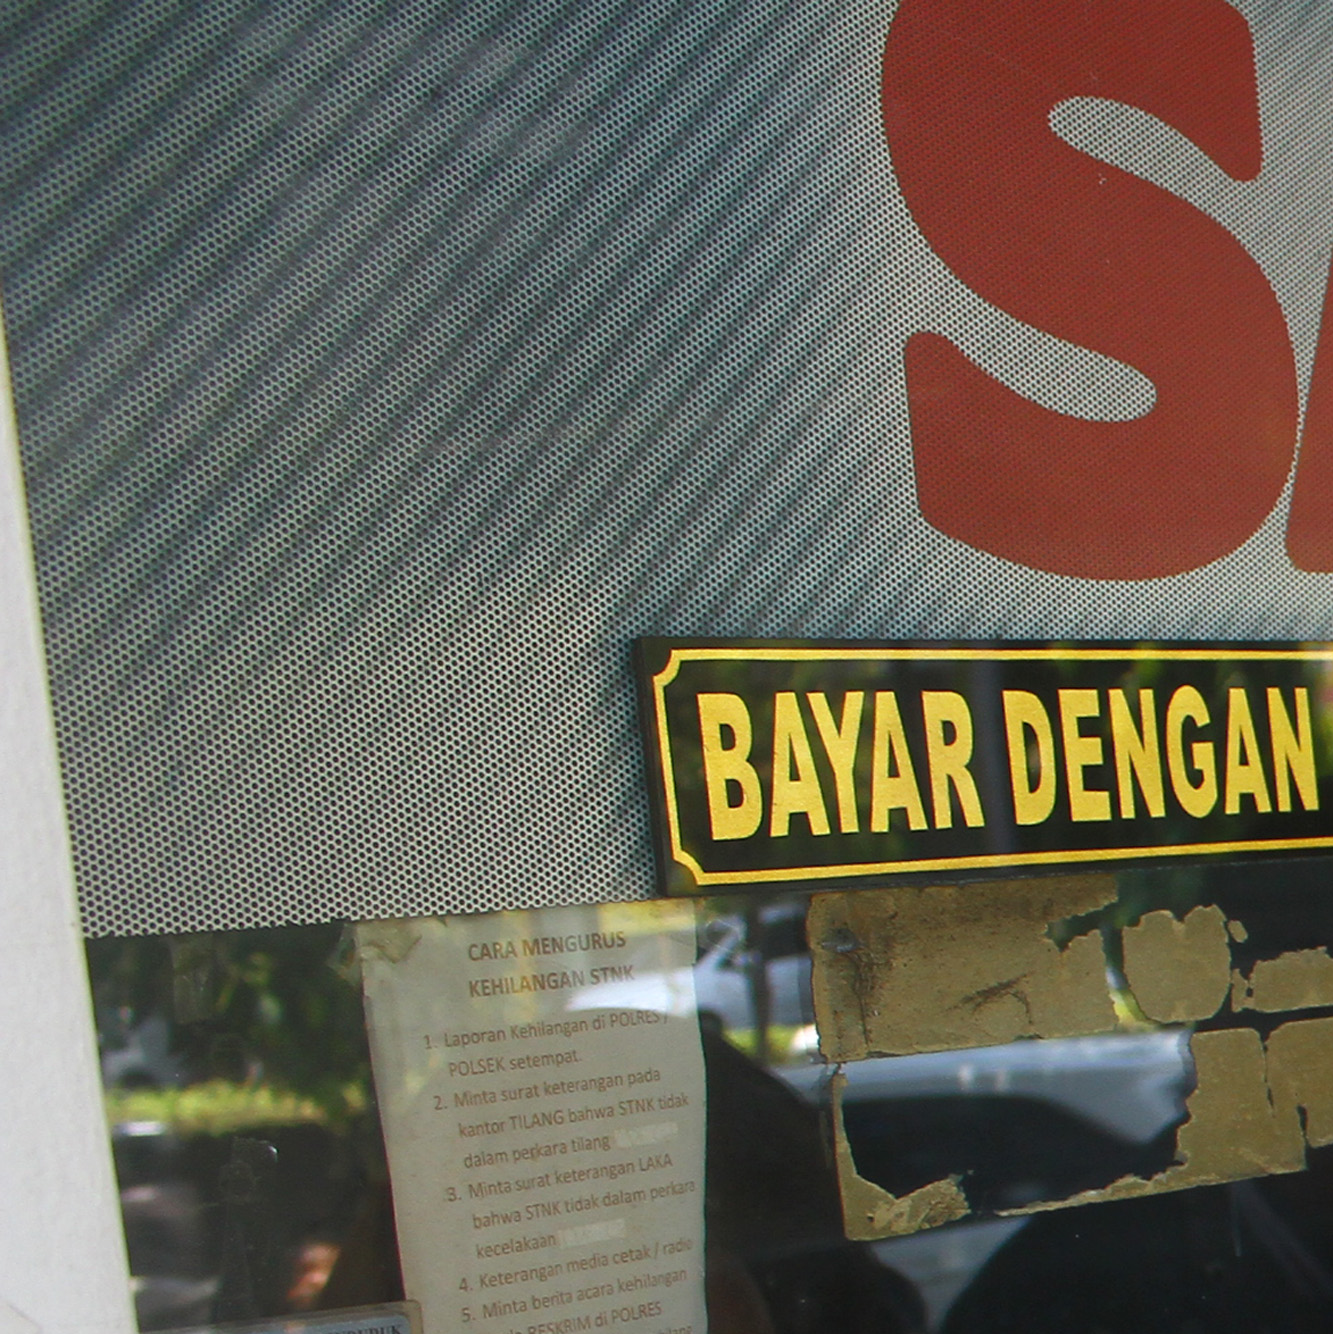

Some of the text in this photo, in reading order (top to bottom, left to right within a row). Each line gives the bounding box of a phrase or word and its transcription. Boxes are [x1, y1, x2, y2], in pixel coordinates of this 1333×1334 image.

[696, 687, 985, 841] BAYAR
[1002, 683, 1321, 827] DENGAN
[468, 930, 627, 962] CARA MENGURUS
[468, 964, 636, 998] KEHILANGAN STNK
[444, 1027, 507, 1050] Laporan
[510, 1019, 589, 1041] Kehilangan
[592, 1013, 607, 1032] di
[609, 1009, 660, 1029] POLRES
[448, 1048, 582, 1078] POLSEK setempat.
[433, 1066, 662, 1111] 2. Minta surat keterangan pada
[457, 1091, 690, 1139] kantor TILANG bahwa STNK tidak
[463, 1134, 611, 1169] dalam perkara tilang
[468, 1179, 513, 1200] Minta
[514, 1172, 551, 1192] surat
[555, 1162, 635, 1186] keterangan
[638, 1152, 674, 1172] LAKA
[472, 1179, 697, 1231] bahwa STNK tidak dalam perkara
[475, 1232, 557, 1260] kecelakaan
[458, 1277, 473, 1293] 4.
[479, 1263, 562, 1290] Keterangan
[566, 1251, 609, 1273] media
[612, 1244, 652, 1265] cetak
[461, 1268, 687, 1323] 5. Minta berita acara kehilangan
[594, 1311, 609, 1328] di
[611, 1300, 663, 1324] POLRES
